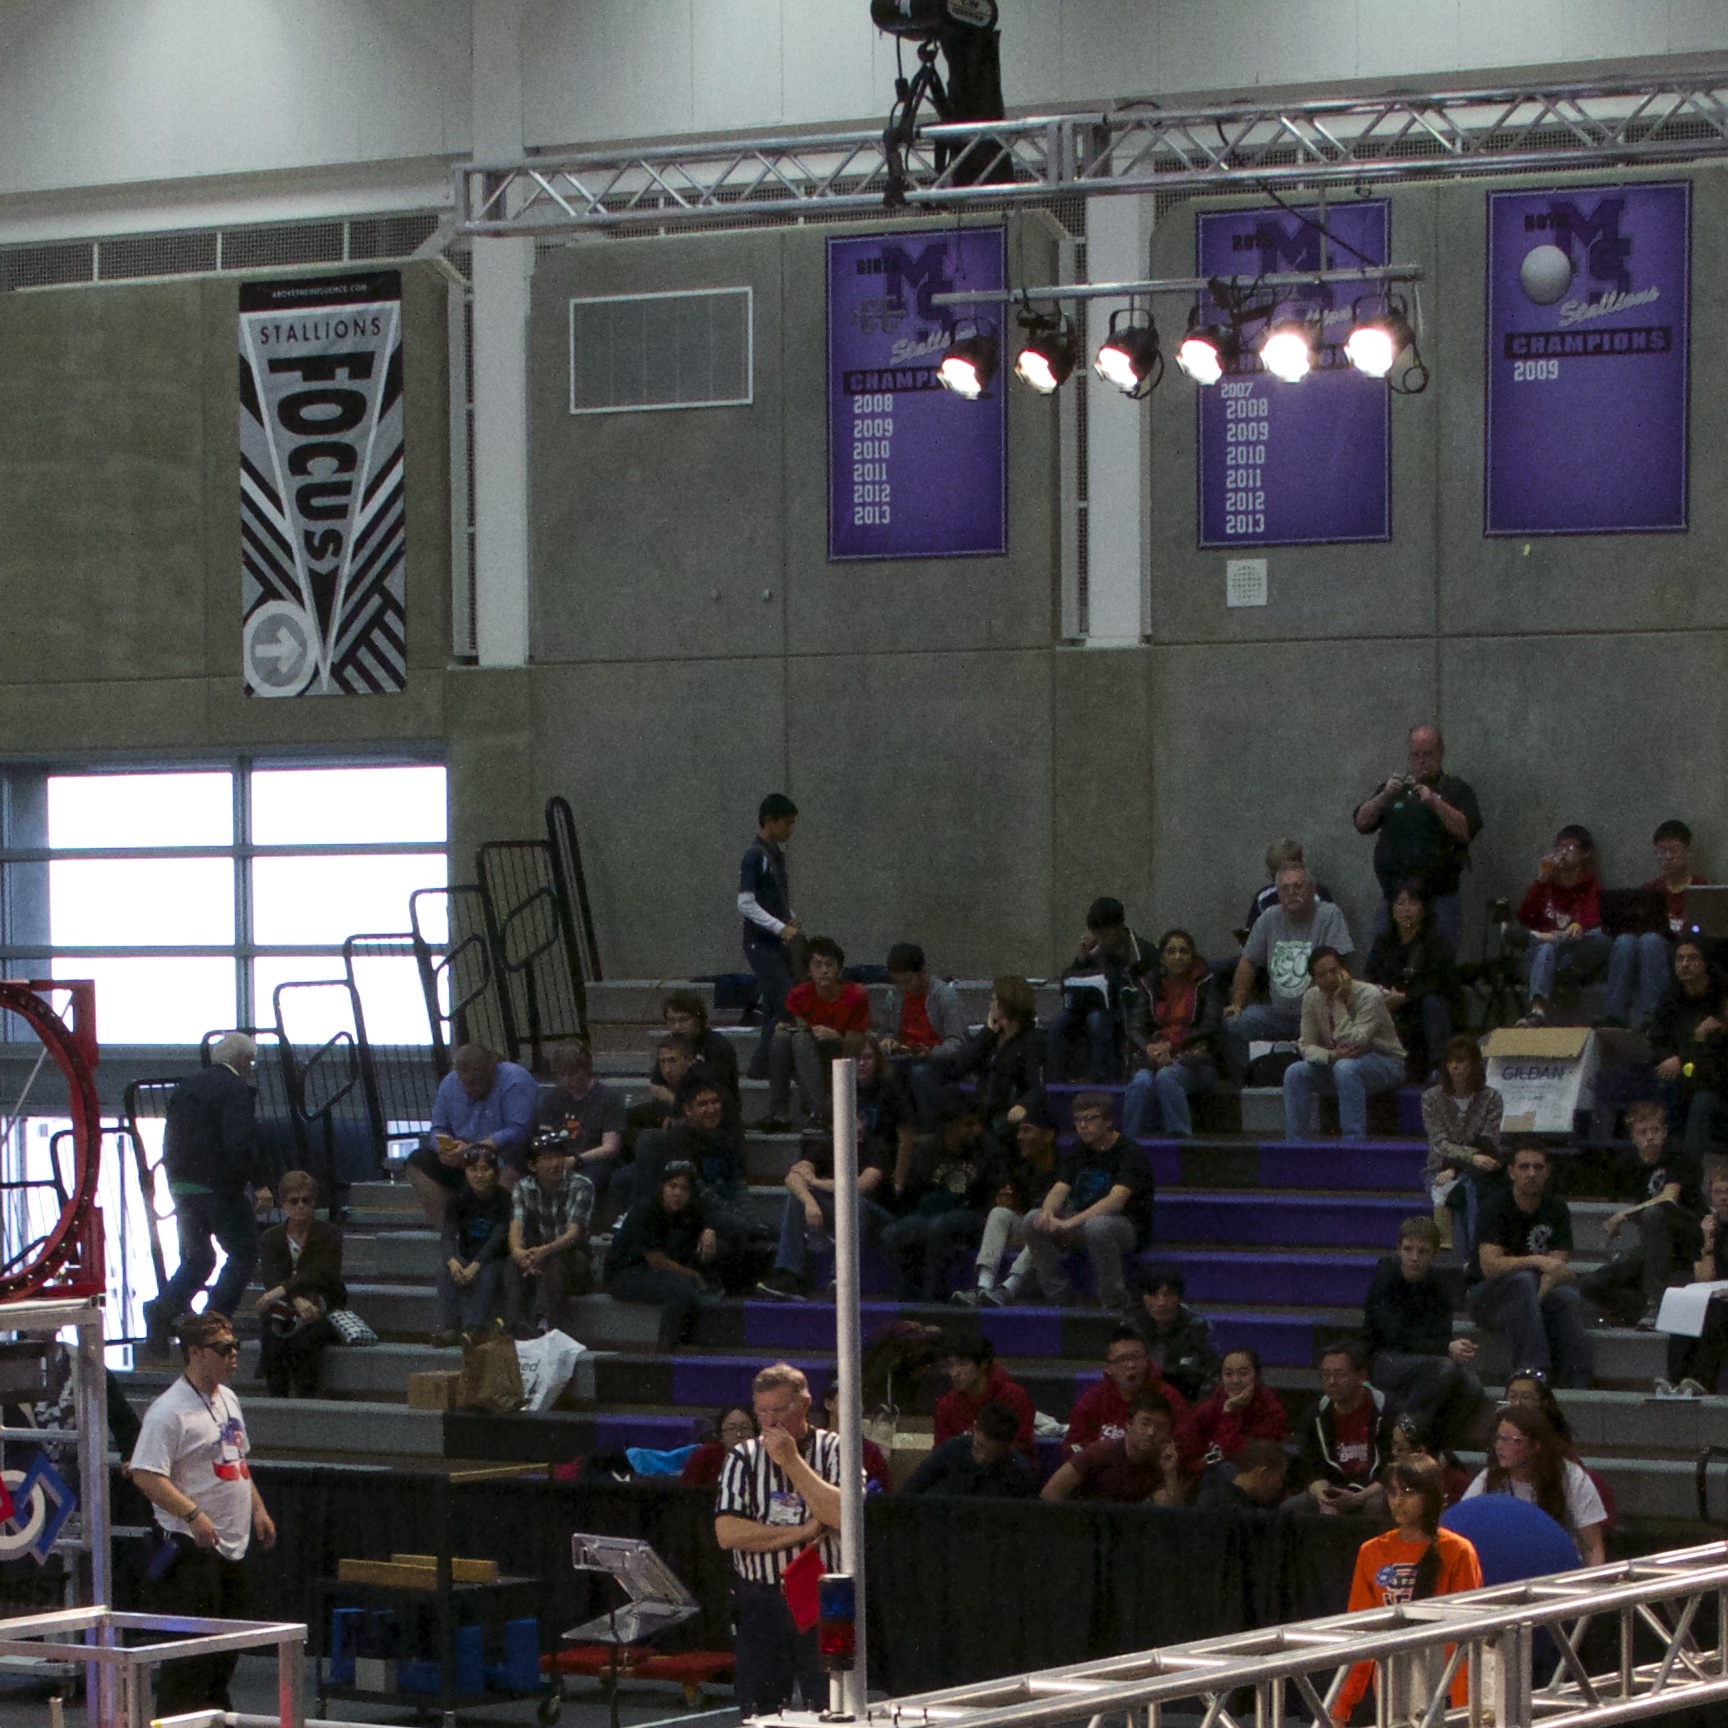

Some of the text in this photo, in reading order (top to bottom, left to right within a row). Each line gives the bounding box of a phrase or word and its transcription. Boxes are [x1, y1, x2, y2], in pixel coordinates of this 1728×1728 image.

[1558, 286, 1660, 326] Stallions
[1512, 329, 1666, 356] CHAMPIONS
[1514, 359, 1559, 382] 2009
[1221, 383, 1253, 399] 2007
[853, 394, 893, 414] 2008
[1226, 399, 1268, 419] 2008
[853, 419, 893, 438] 2009
[1226, 422, 1268, 441] 2009
[267, 351, 376, 561] FOCUS
[853, 441, 890, 460] 2010
[1226, 446, 1265, 465] 2010
[853, 463, 887, 482] 2011
[1226, 469, 1262, 488] 2011
[853, 485, 890, 503] 2012
[1225, 492, 1265, 512] 2012
[853, 506, 890, 525] 2013
[1225, 515, 1265, 534] 2013
